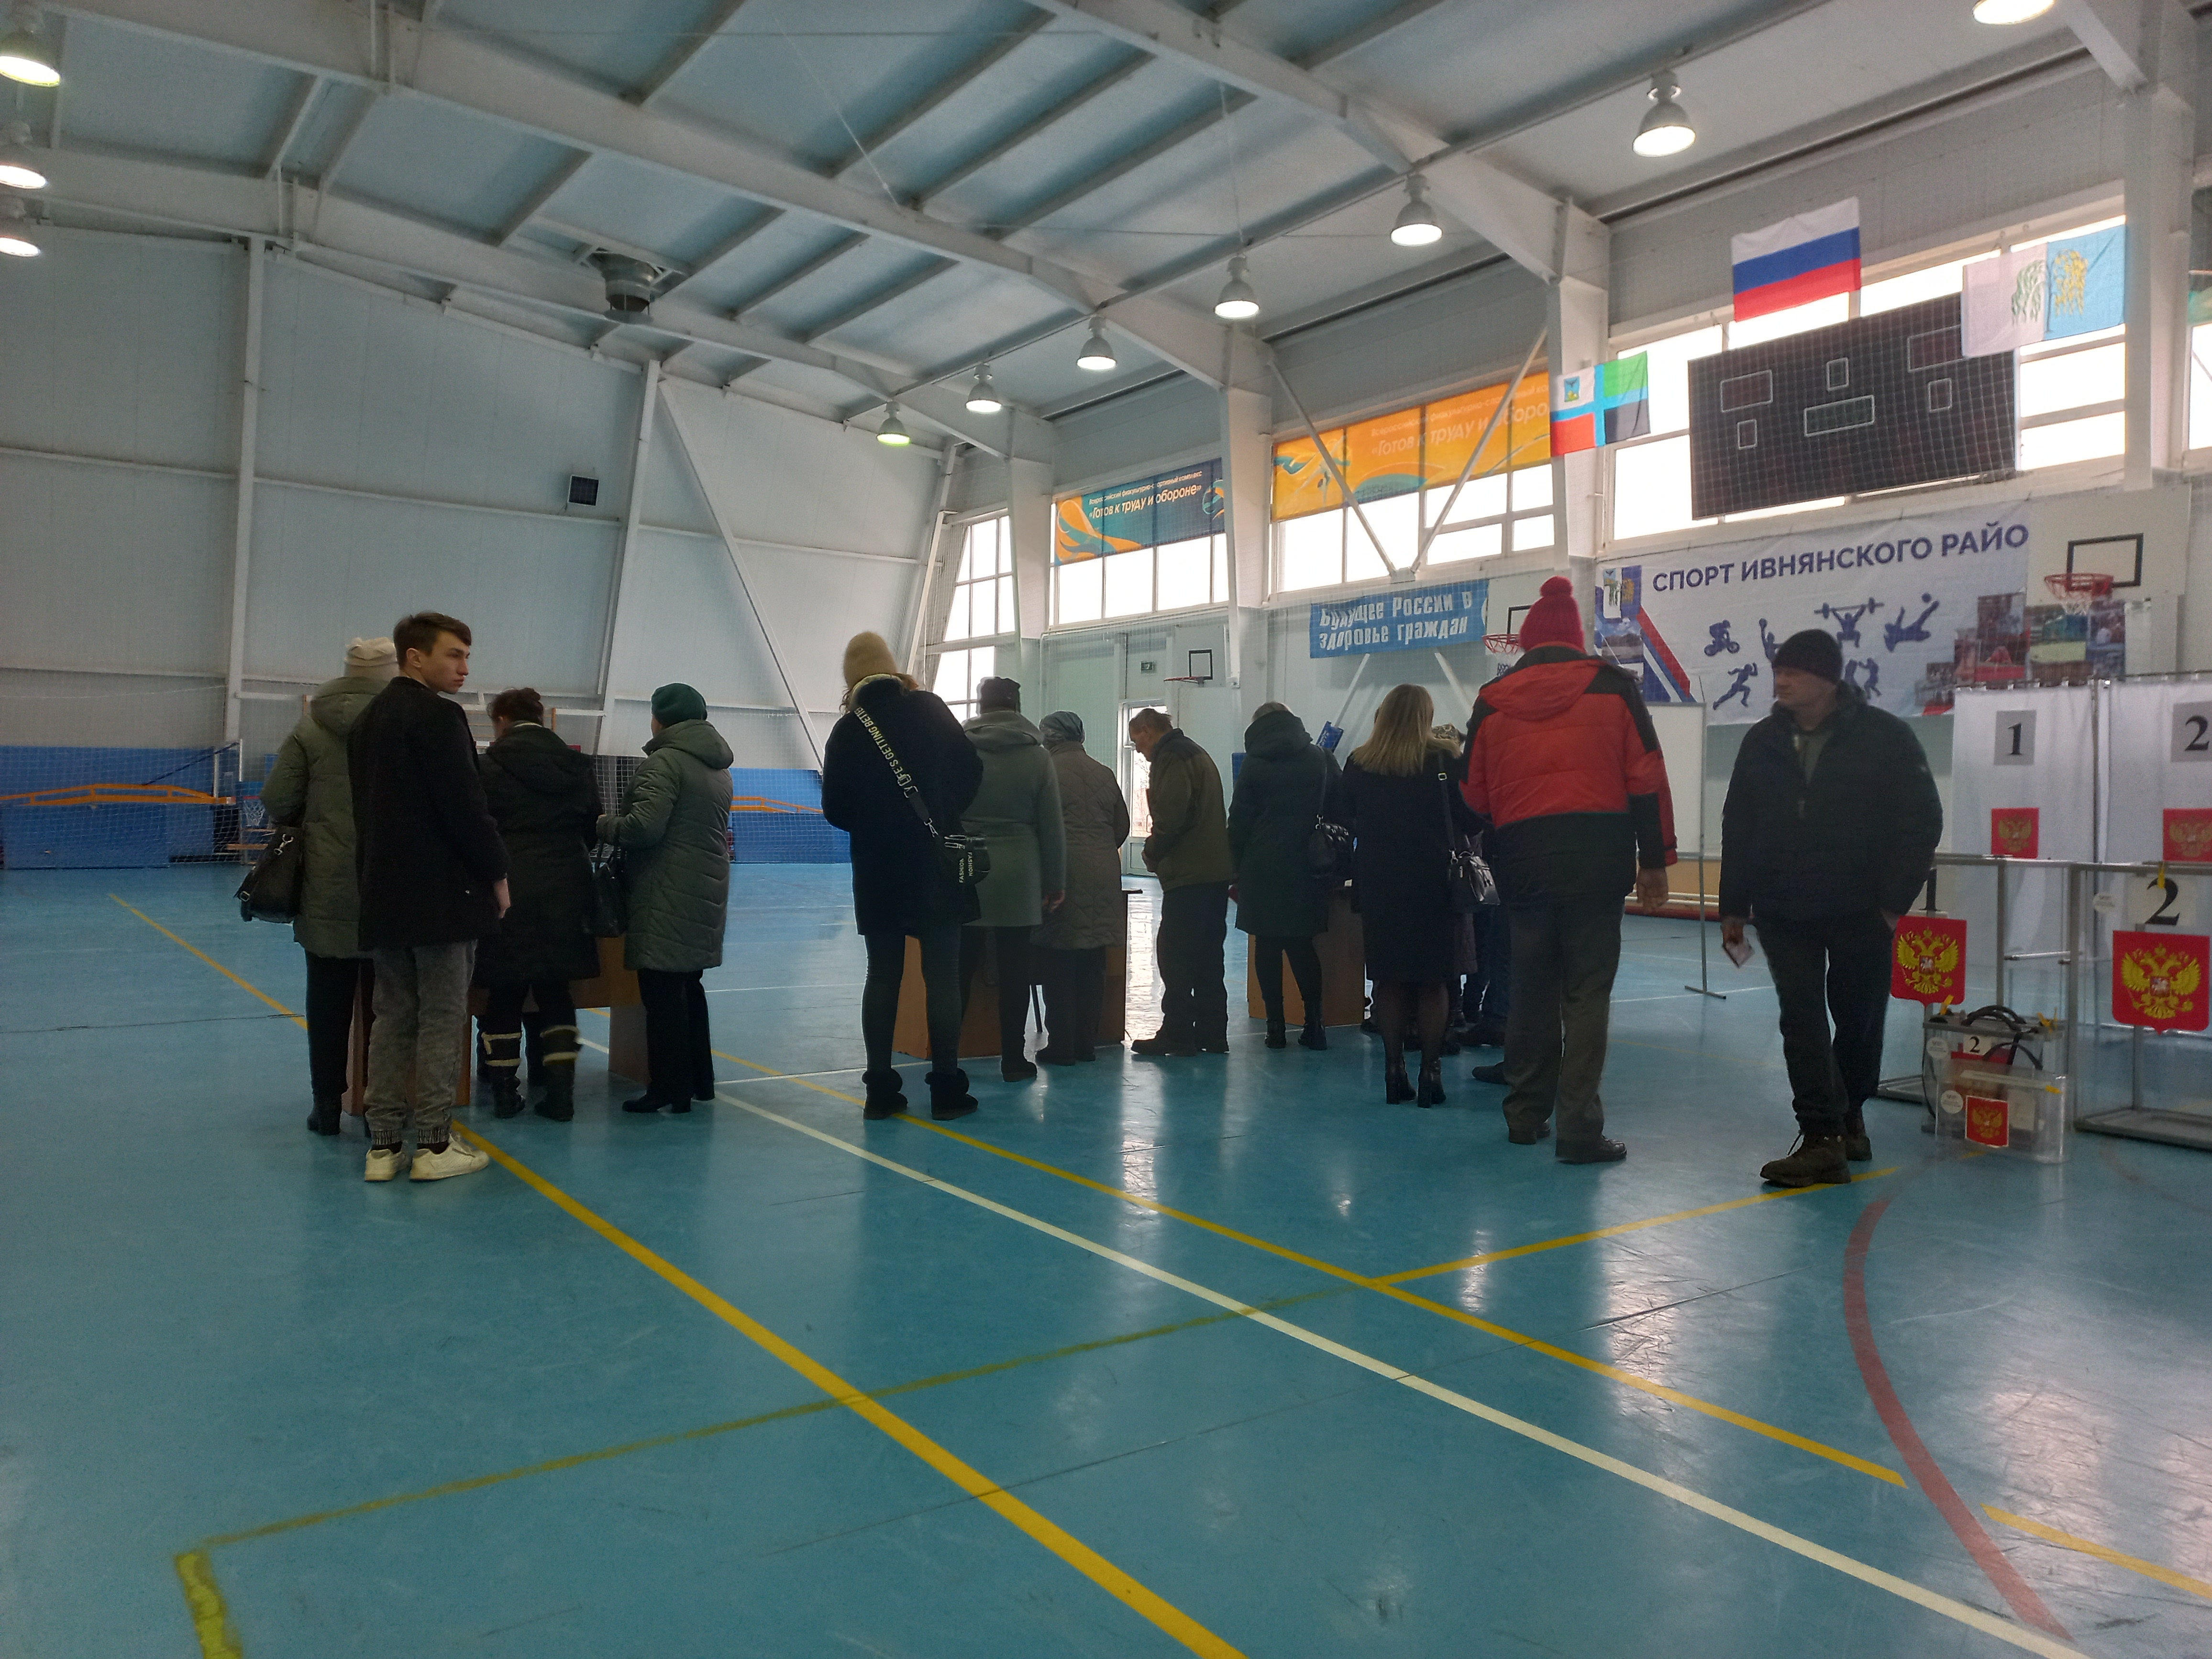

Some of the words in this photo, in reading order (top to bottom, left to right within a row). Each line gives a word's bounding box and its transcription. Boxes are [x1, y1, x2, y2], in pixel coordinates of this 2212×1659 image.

[1114, 503, 1121, 514] к
[1121, 497, 1147, 514] труду
[1147, 495, 1154, 506] и
[1653, 563, 1735, 592] СПОРТ
[1741, 536, 1933, 582] ИВНЯНСКОГО
[1941, 521, 2029, 557] РАЙО
[1392, 594, 1454, 618] России
[1397, 616, 1468, 645] граждан
[868, 726, 894, 760] GETTING
[2007, 722, 2023, 755] 1
[2185, 715, 2210, 751] 2
[2145, 877, 2180, 926] 2
[1969, 1036, 1980, 1053] 2
